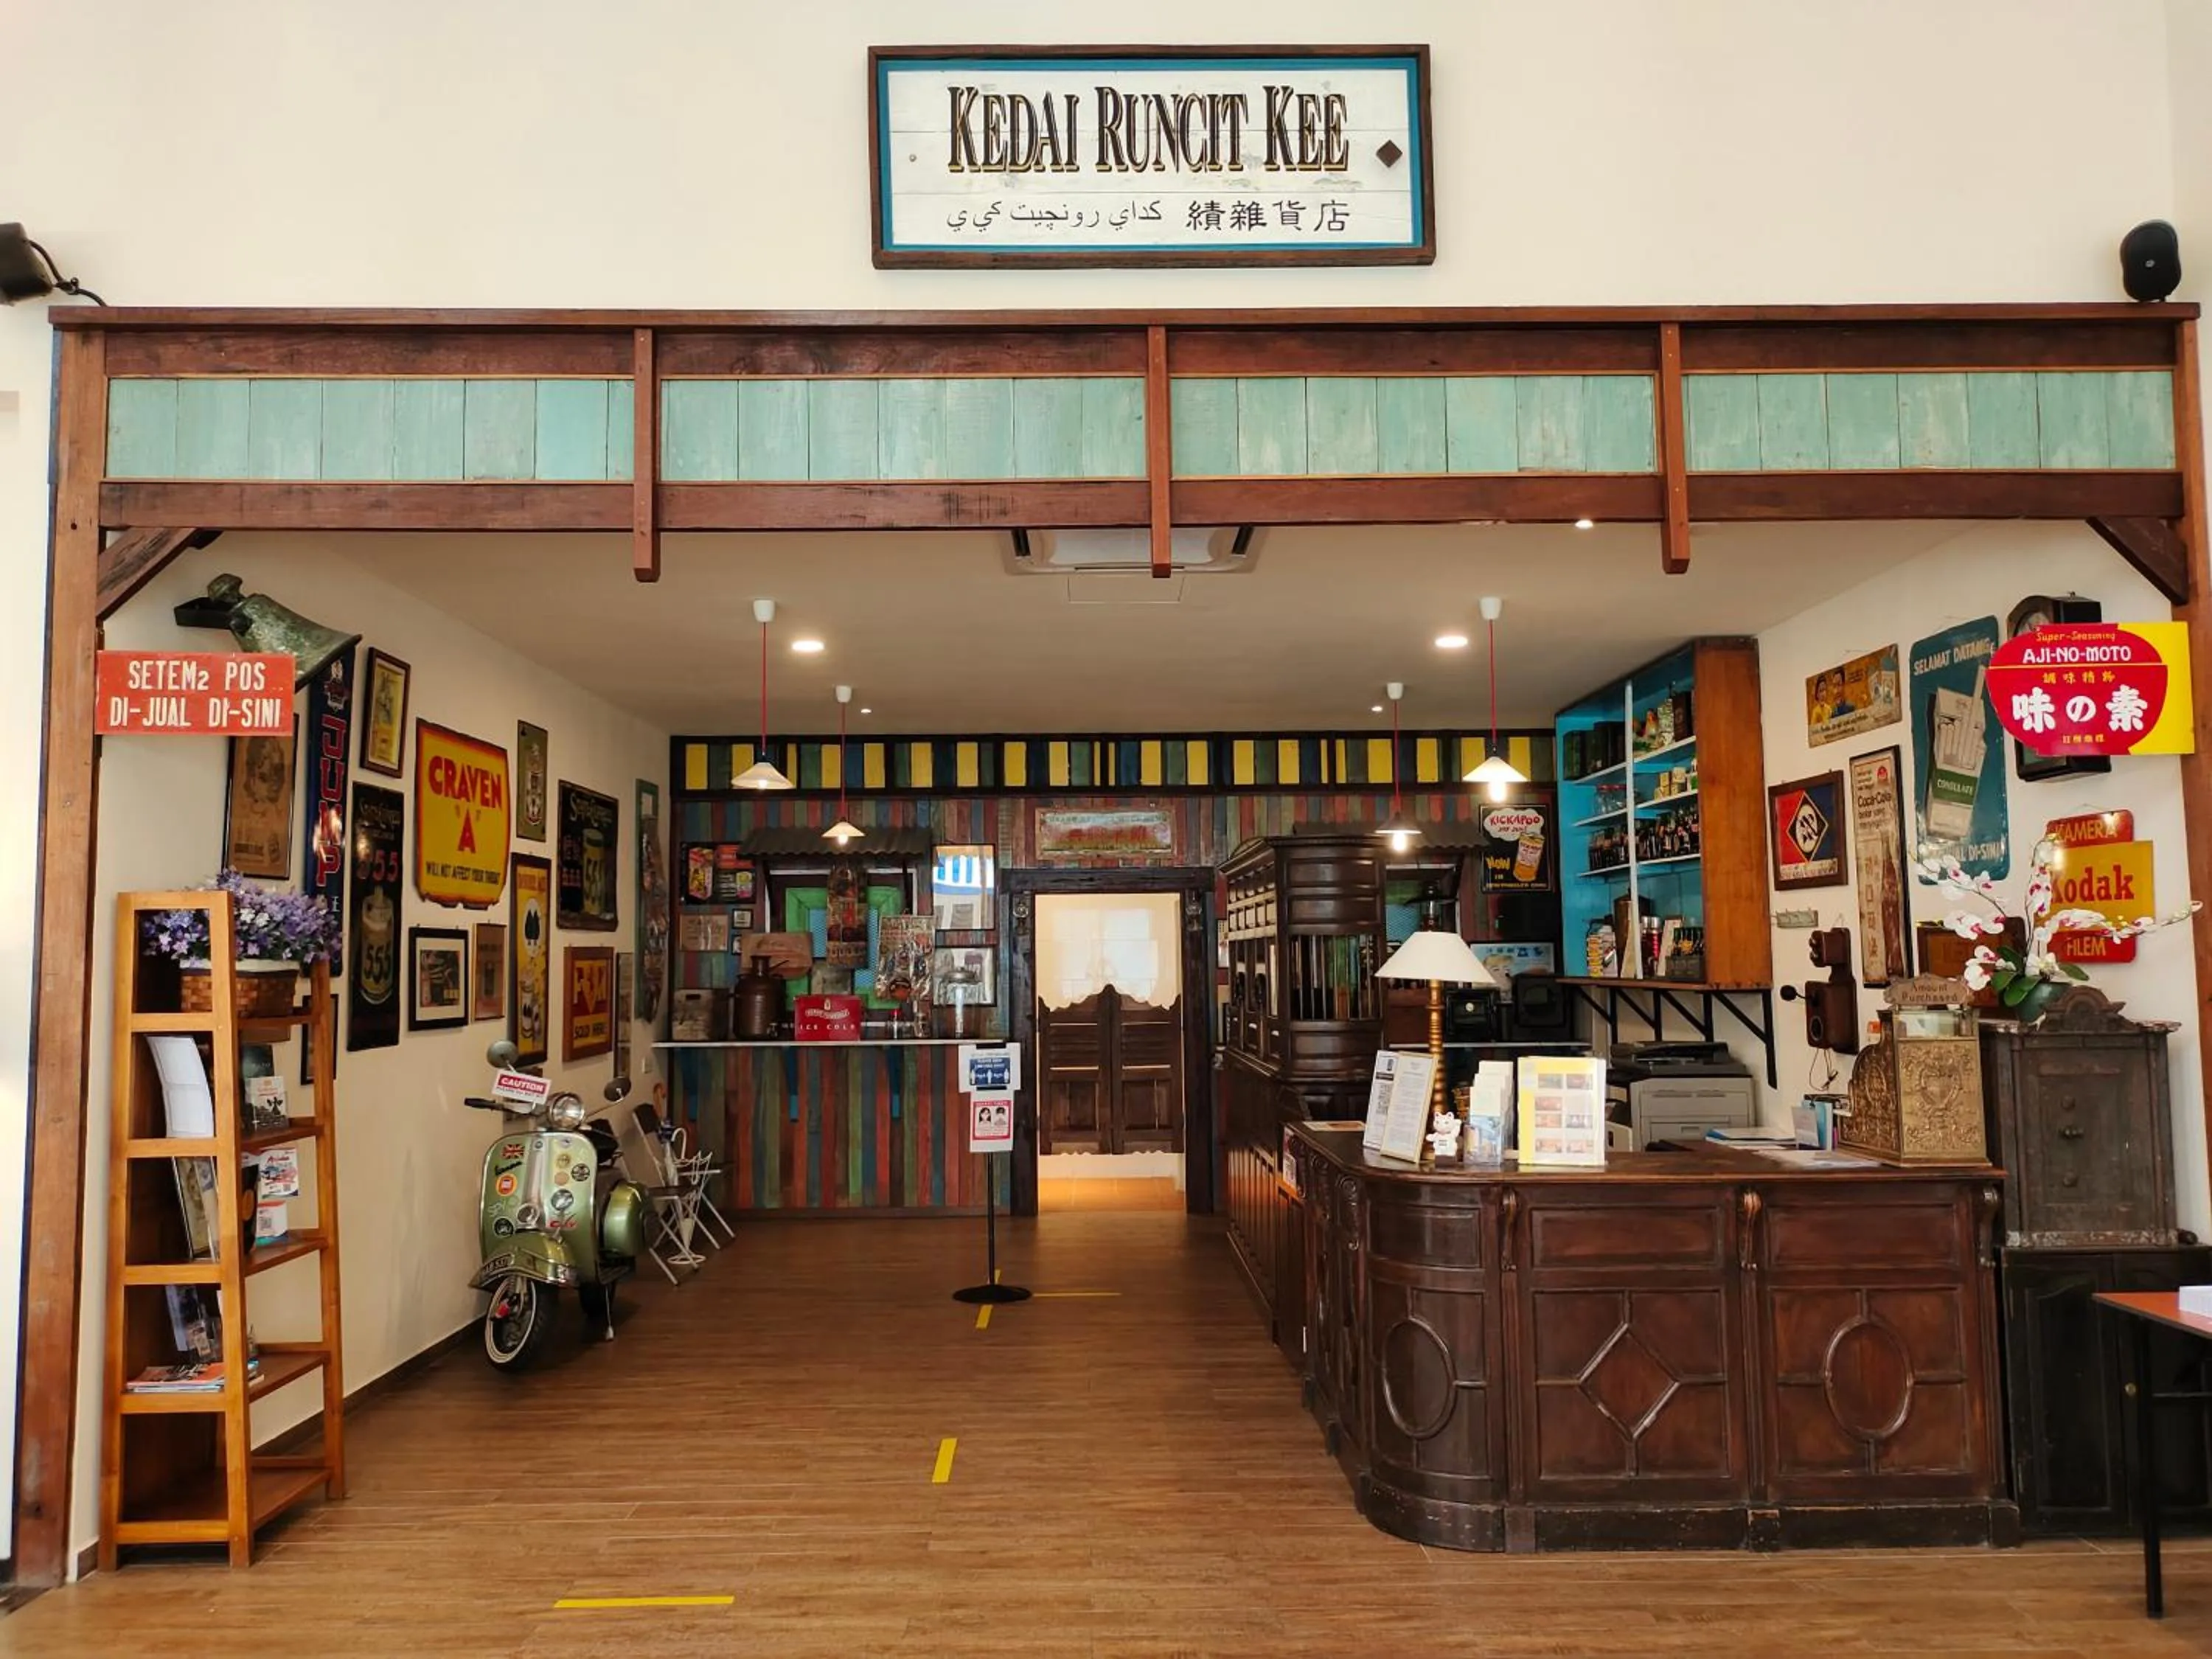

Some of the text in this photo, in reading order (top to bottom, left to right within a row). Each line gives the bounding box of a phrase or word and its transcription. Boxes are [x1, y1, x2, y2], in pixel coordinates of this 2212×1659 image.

[947, 85, 1349, 174] KEDAI RUNCIT KEE
[1186, 199, 1350, 232] 績雜貨店
[2023, 644, 2132, 664] AJI-NO-MOTO
[224, 661, 266, 692] POS
[109, 695, 282, 728] DI-JUAL DI-SINI
[2011, 684, 2148, 734] 味の素
[428, 754, 502, 810] CRAVEN
[1490, 815, 1540, 826] KICKAPOO
[2055, 818, 2118, 841] KAMERA
[501, 1077, 544, 1092] CAUTION
